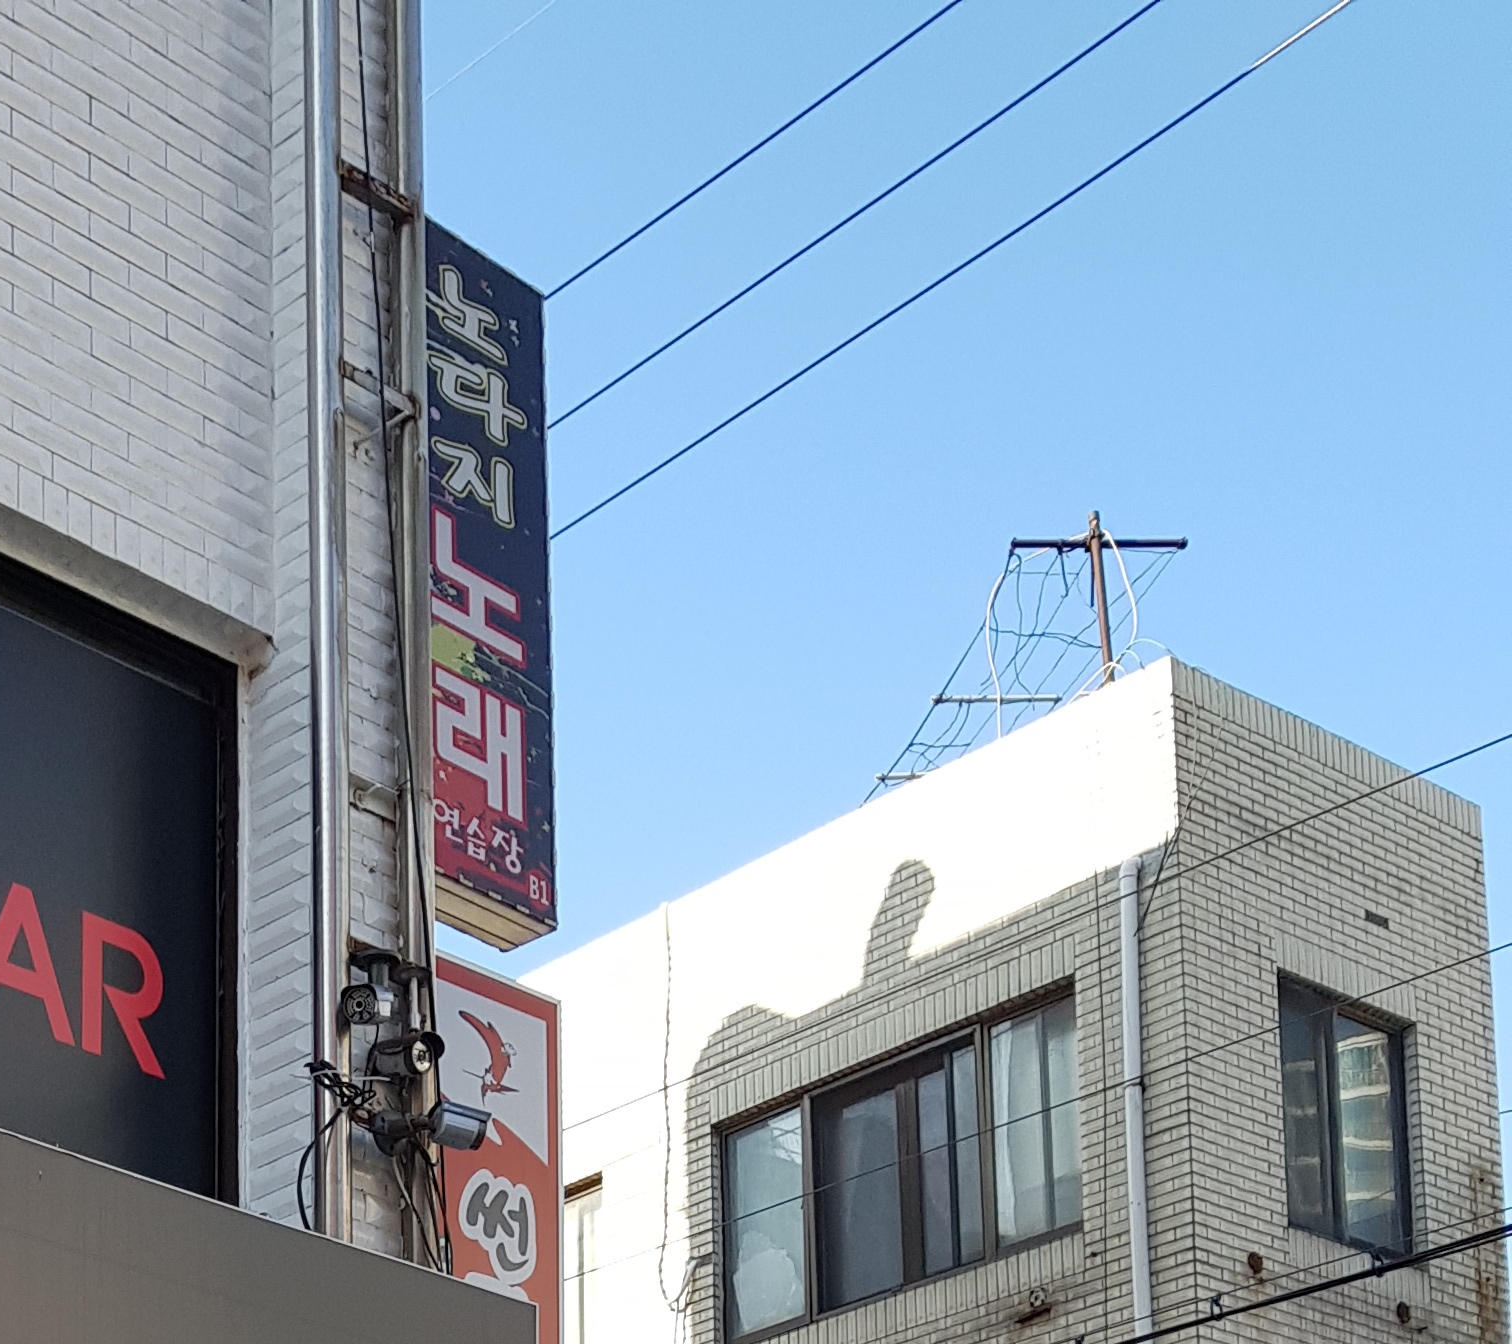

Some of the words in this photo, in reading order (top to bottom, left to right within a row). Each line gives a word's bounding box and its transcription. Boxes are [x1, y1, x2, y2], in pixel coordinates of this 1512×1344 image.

[430, 504, 528, 828] 노래
[432, 802, 524, 876] 연습장
[528, 872, 550, 907] B1
